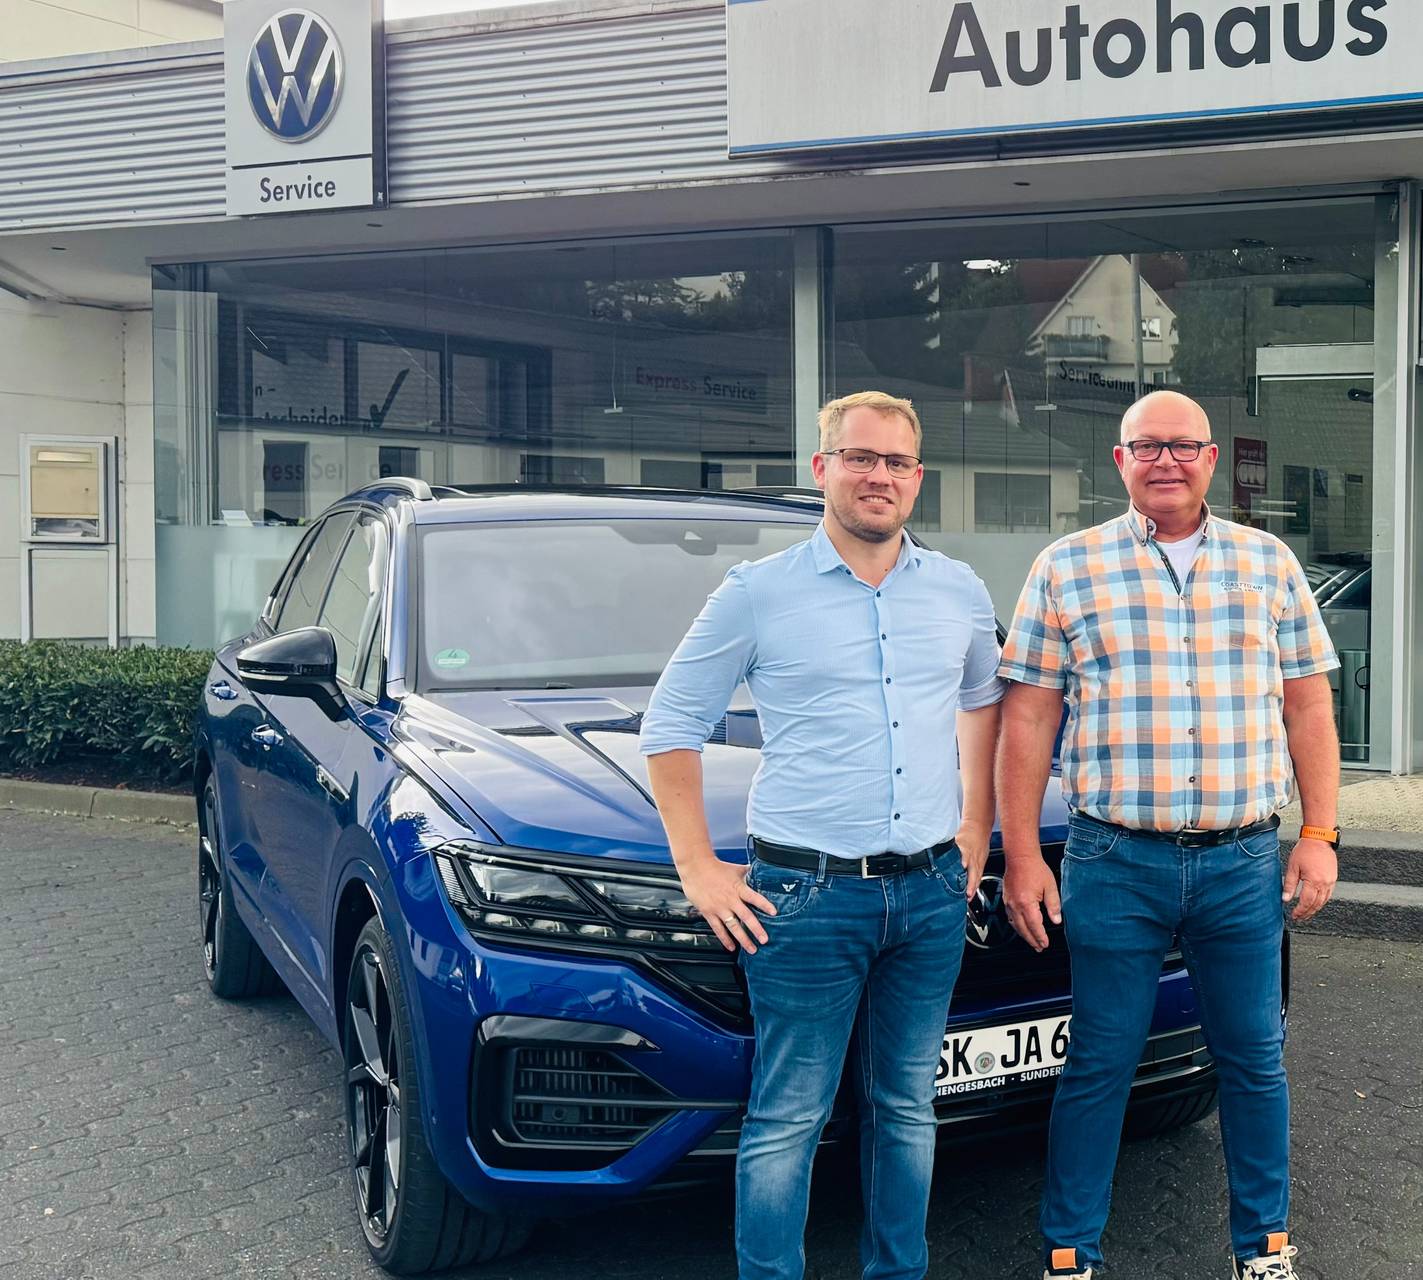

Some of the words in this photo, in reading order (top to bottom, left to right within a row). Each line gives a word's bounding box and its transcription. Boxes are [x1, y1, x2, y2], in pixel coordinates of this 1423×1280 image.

[928, 0, 1388, 93] Autohaus
[260, 175, 336, 203] Service
[703, 376, 757, 400] Service
[1001, 1025, 1043, 1069] JA
[1051, 1020, 1072, 1060] 6
[936, 1076, 1005, 1098] HENGESBACH
[1020, 1066, 1064, 1082] SUNDER
